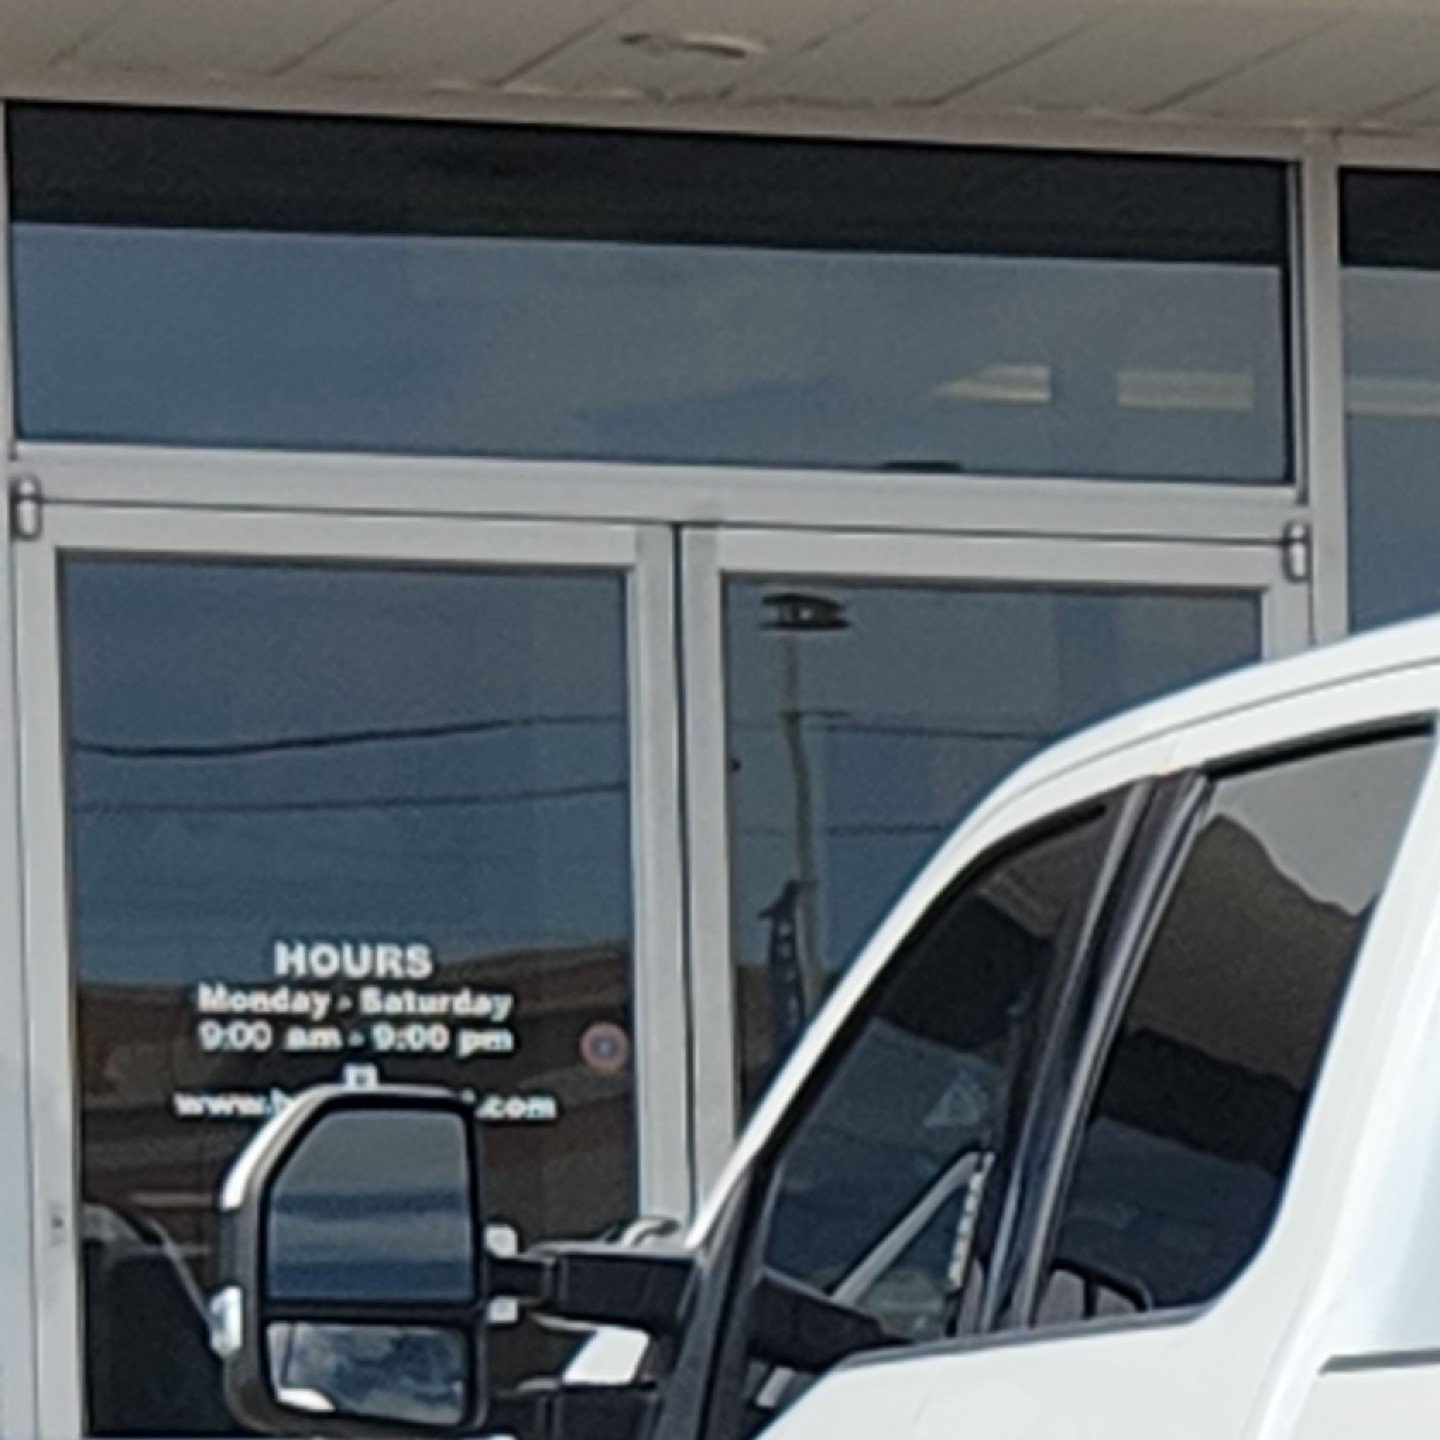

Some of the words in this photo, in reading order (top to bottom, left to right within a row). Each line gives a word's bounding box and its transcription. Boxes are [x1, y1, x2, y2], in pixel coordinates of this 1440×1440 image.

[273, 939, 434, 978] HOURS
[197, 982, 332, 1020] Monday
[358, 985, 514, 1021] Saturday
[198, 1020, 274, 1052] 9:00
[371, 1021, 450, 1052] 9:00
[456, 1027, 516, 1057] pm
